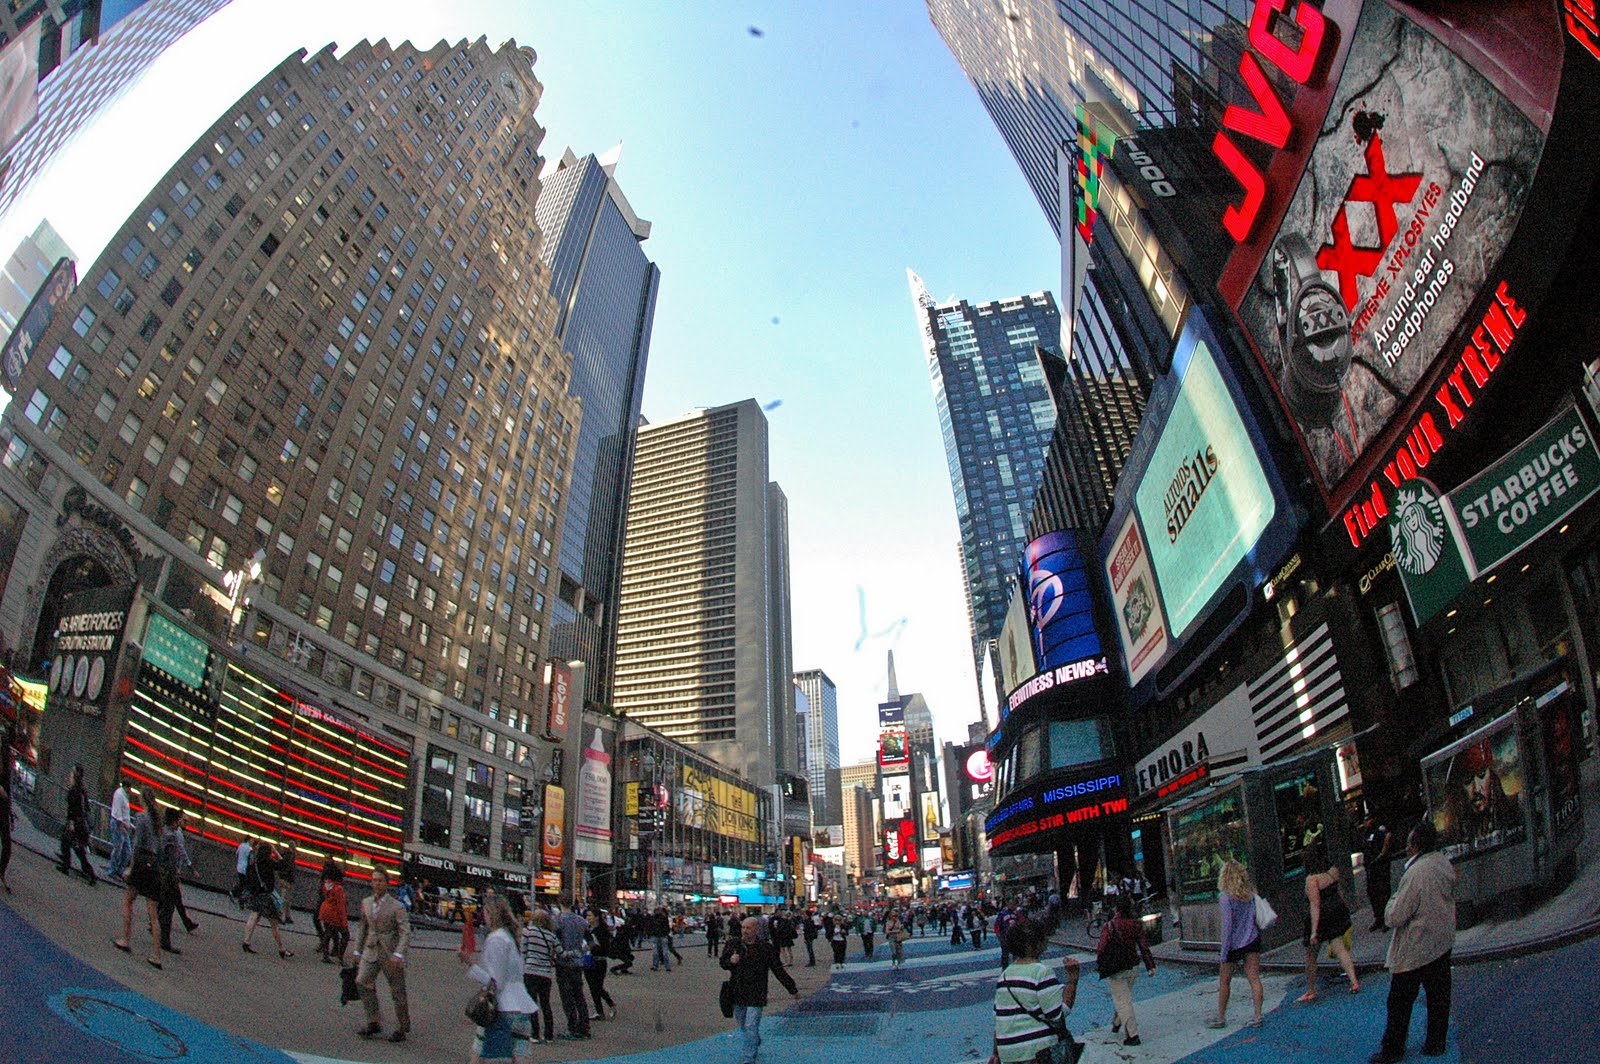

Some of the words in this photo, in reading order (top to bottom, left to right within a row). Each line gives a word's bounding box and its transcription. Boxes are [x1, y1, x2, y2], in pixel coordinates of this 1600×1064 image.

[1121, 138, 1177, 198] 1500
[1212, 0, 1325, 243] JVC
[1350, 277, 1391, 346] XTREME
[1386, 181, 1443, 281] XPLOSIVES
[1373, 248, 1436, 351] Around-ear
[1430, 151, 1485, 251] headband
[1381, 257, 1455, 368] headphones
[1342, 480, 1390, 548] Find
[1383, 410, 1444, 489] YOUR
[1434, 279, 1528, 430] XTREME
[1163, 454, 1191, 519] ALTOIDS
[1166, 444, 1218, 545] smalls
[1460, 425, 1588, 529] STARBUCKS
[1496, 462, 1581, 535] COFFEE
[1008, 671, 1055, 713] EYEWITNESS
[1055, 659, 1096, 686] NEWS
[1039, 813, 1065, 832] STIR
[1066, 806, 1100, 824] WITH
[1102, 798, 1128, 816] TWI
[1043, 775, 1121, 804] MISSISSIPPI
